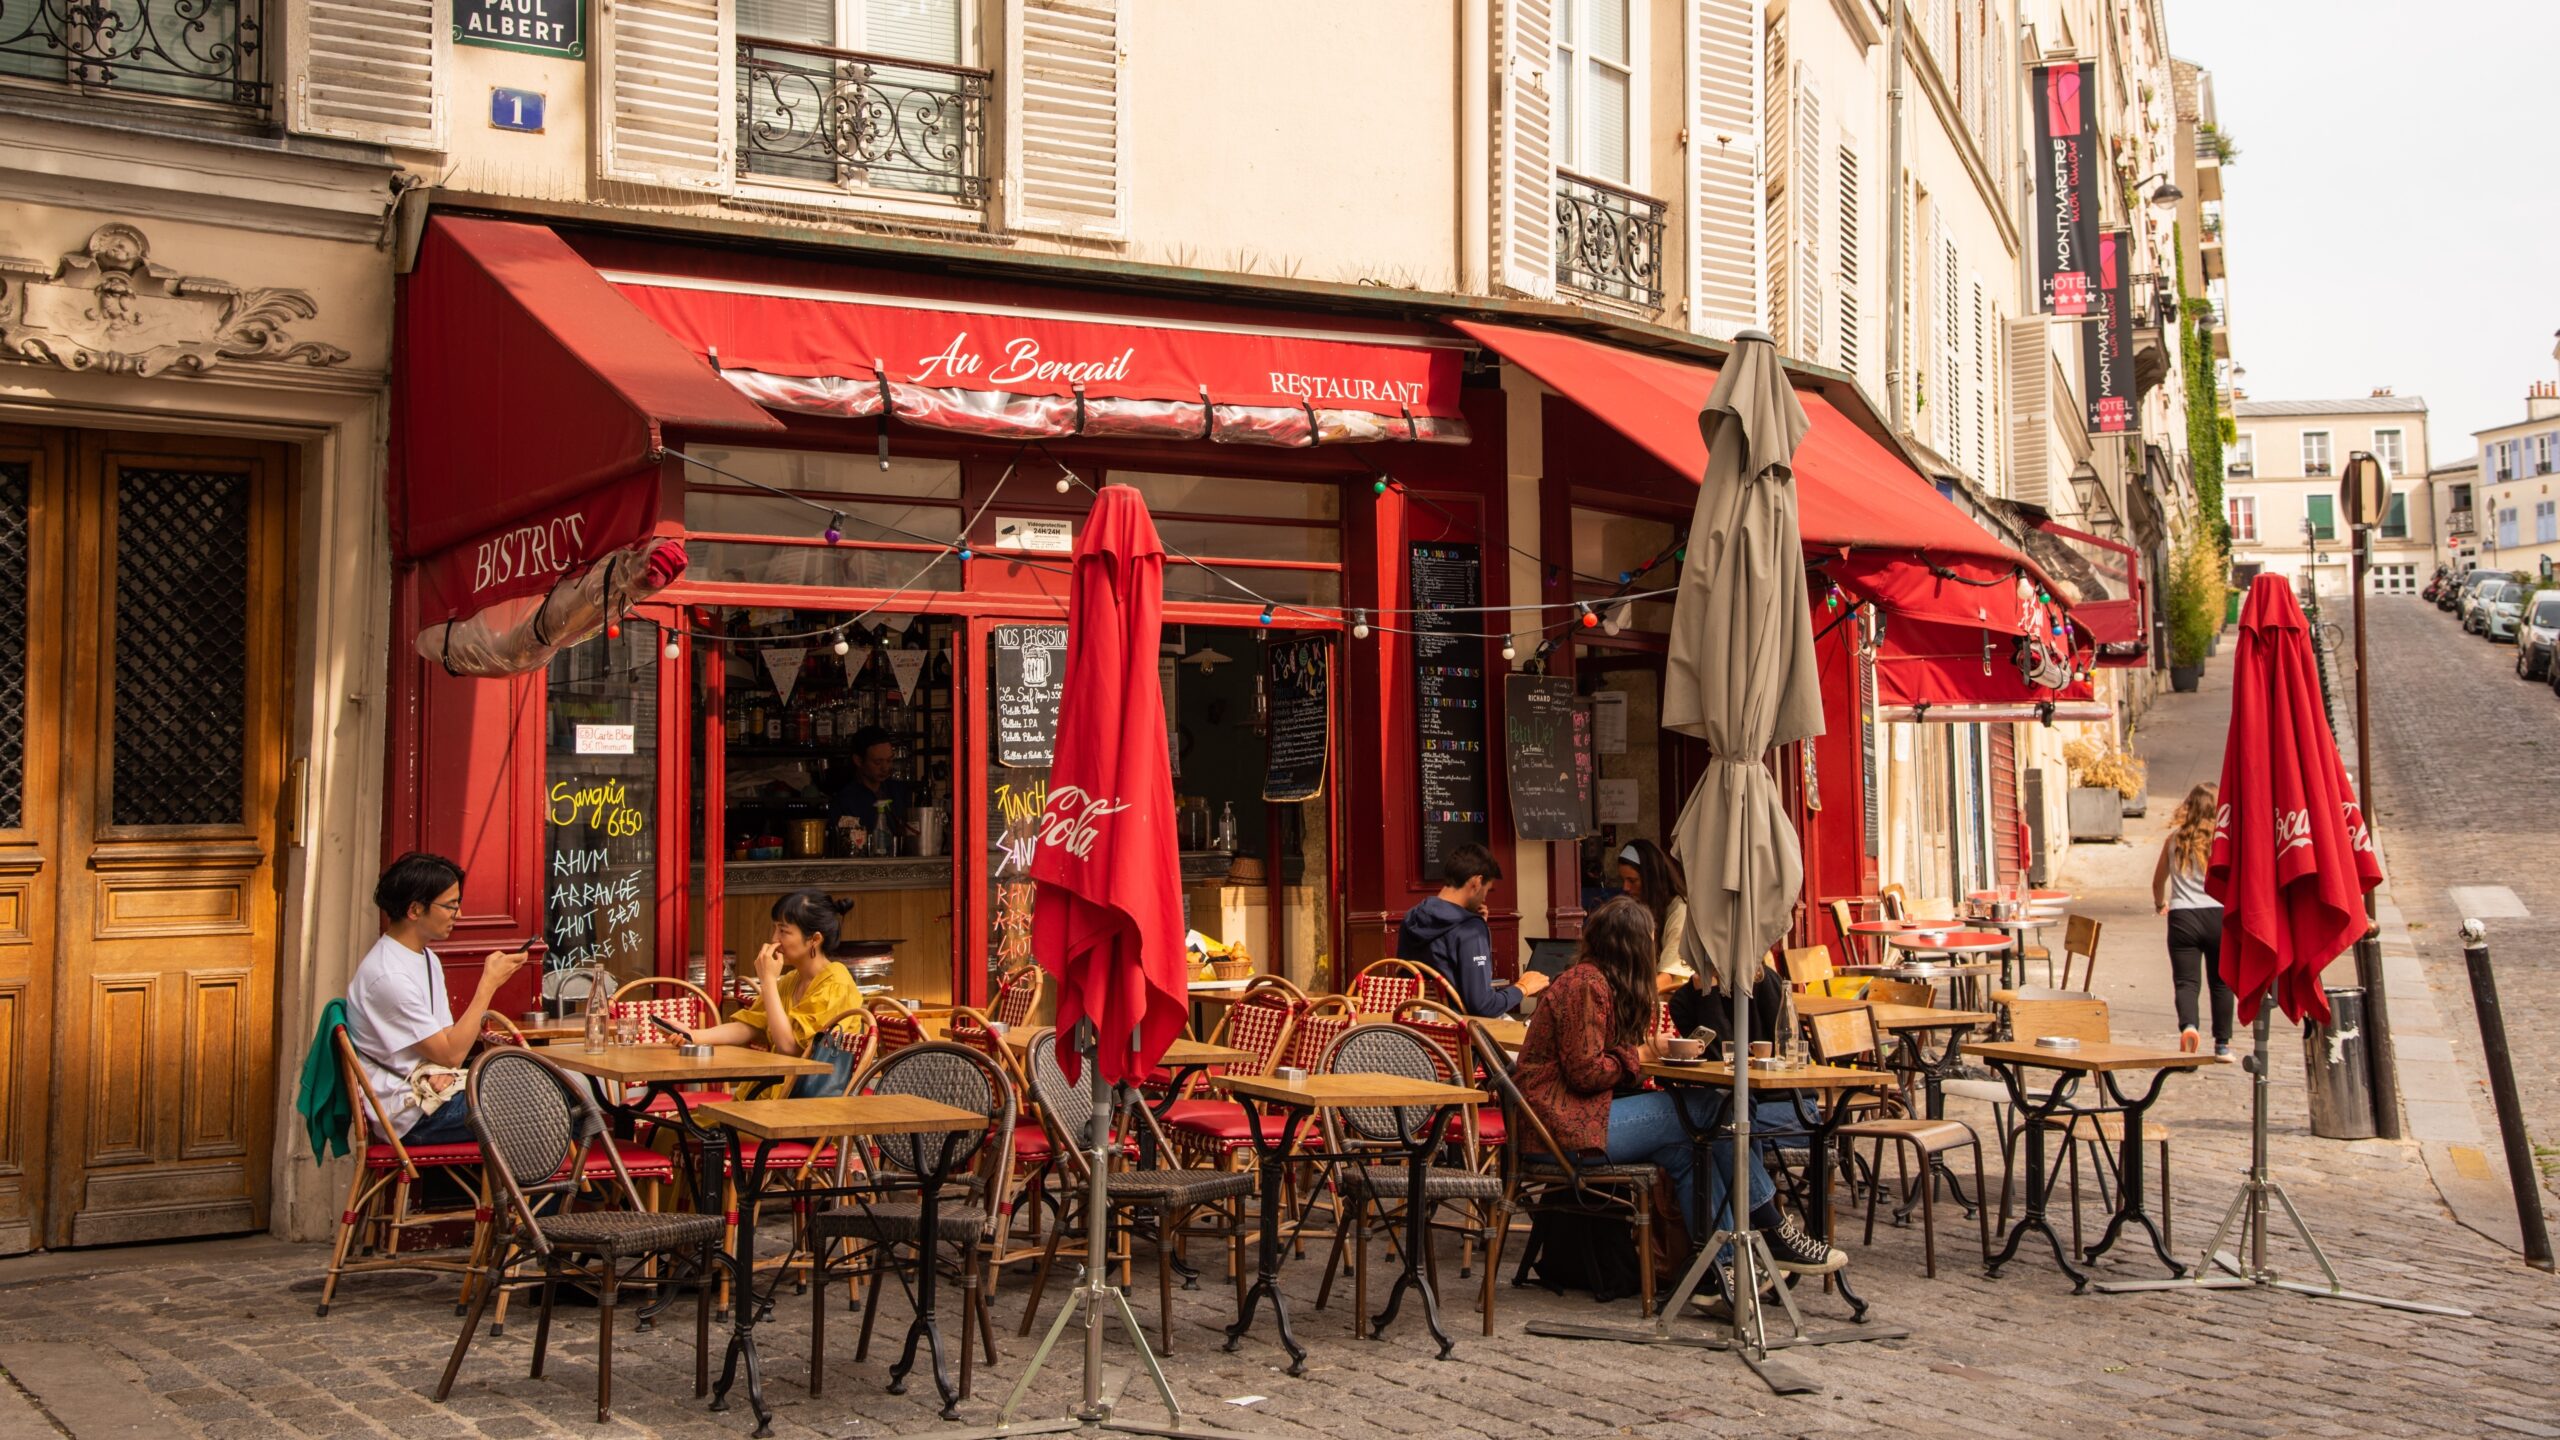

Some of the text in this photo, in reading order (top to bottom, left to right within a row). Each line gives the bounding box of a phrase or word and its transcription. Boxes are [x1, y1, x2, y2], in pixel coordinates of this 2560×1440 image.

[468, 12, 565, 43] ALBERT
[510, 95, 524, 125] 1
[2053, 138, 2071, 271] MONTMARTRE
[906, 331, 1135, 384] Au Bercail
[1268, 371, 1423, 405] RESTAURANT
[551, 777, 626, 830] Sangria
[994, 779, 1046, 826] PUNCH
[2274, 807, 2311, 847] oca
[553, 848, 610, 877] RHUM
[554, 908, 599, 947] SHOT
